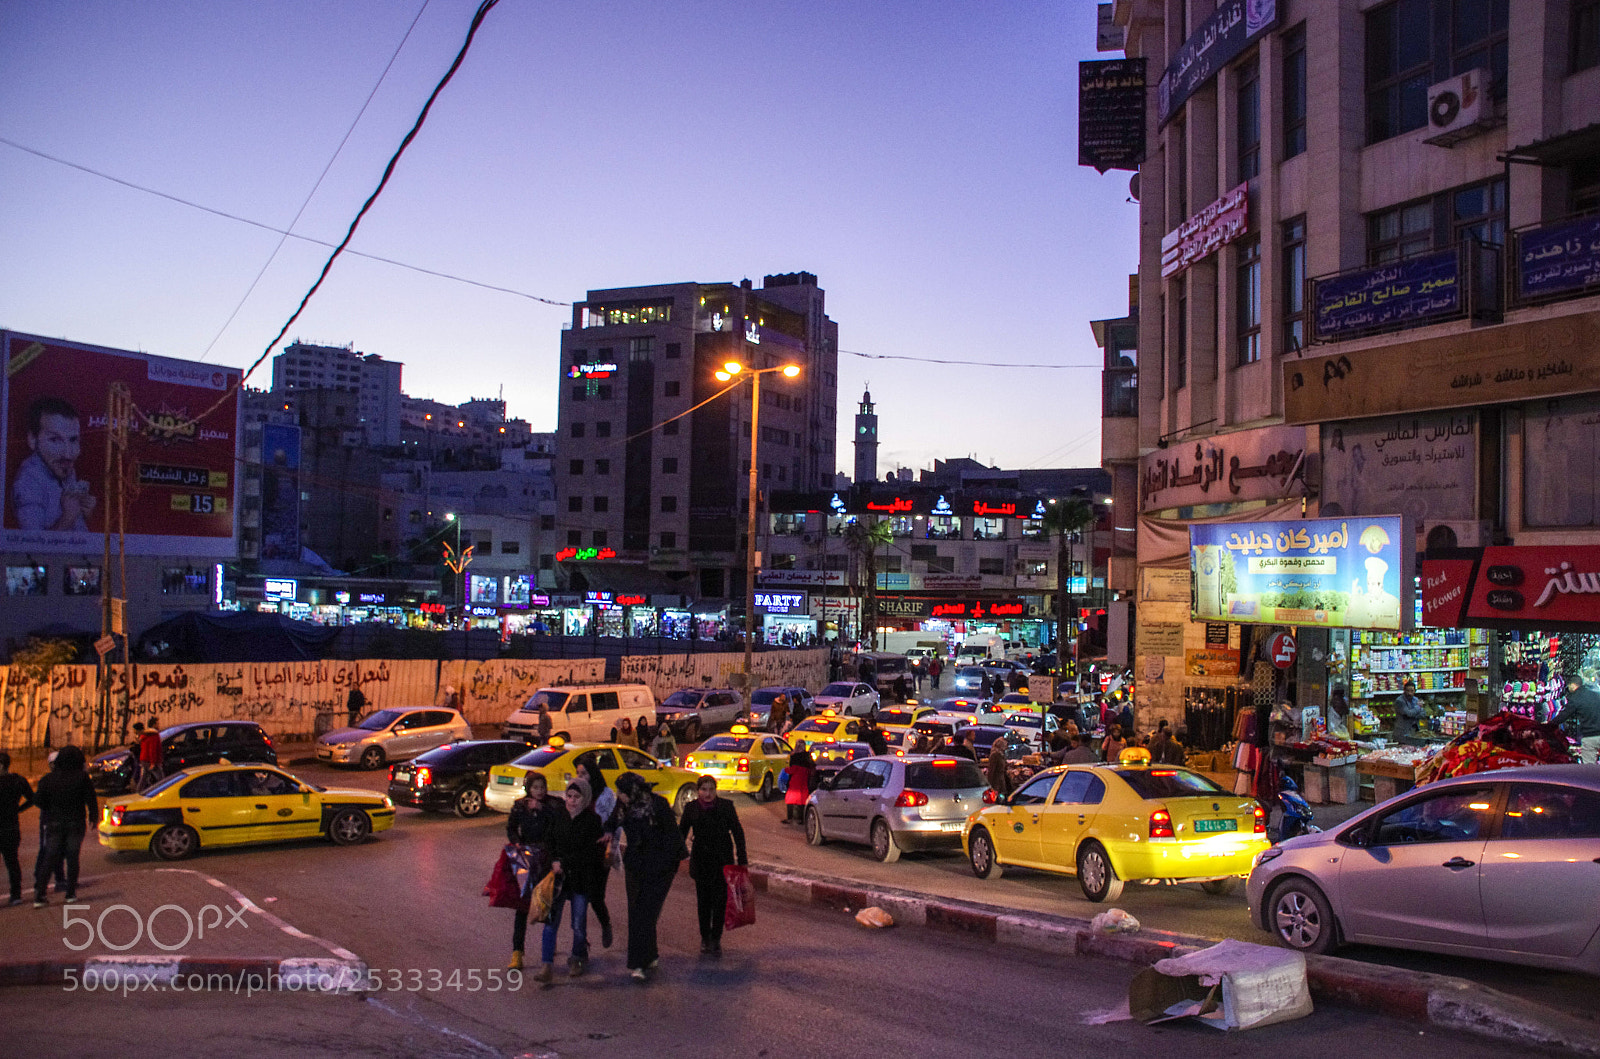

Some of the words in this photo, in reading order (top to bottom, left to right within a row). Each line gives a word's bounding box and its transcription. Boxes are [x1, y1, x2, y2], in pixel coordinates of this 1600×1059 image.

[1364, 267, 1402, 289] الدكتور
[1418, 275, 1456, 293] سمير
[1372, 285, 1411, 305] صالح
[1375, 420, 1419, 452] الماسي
[1425, 415, 1474, 442] الفارس
[1381, 449, 1421, 467] والتسويق
[1425, 446, 1465, 464] للاستيراد
[1170, 443, 1224, 493] الرشاد
[193, 495, 212, 513] 15
[1226, 530, 1273, 555] ديليت
[1276, 522, 1349, 554] أميركان
[1279, 558, 1302, 568] وقهوة
[1303, 559, 1325, 567] محمص
[1426, 570, 1448, 589] Red
[754, 594, 802, 607] PARTY
[879, 601, 924, 613] SHARIF
[1425, 585, 1462, 613] Flower
[253, 665, 292, 690] الصبايا
